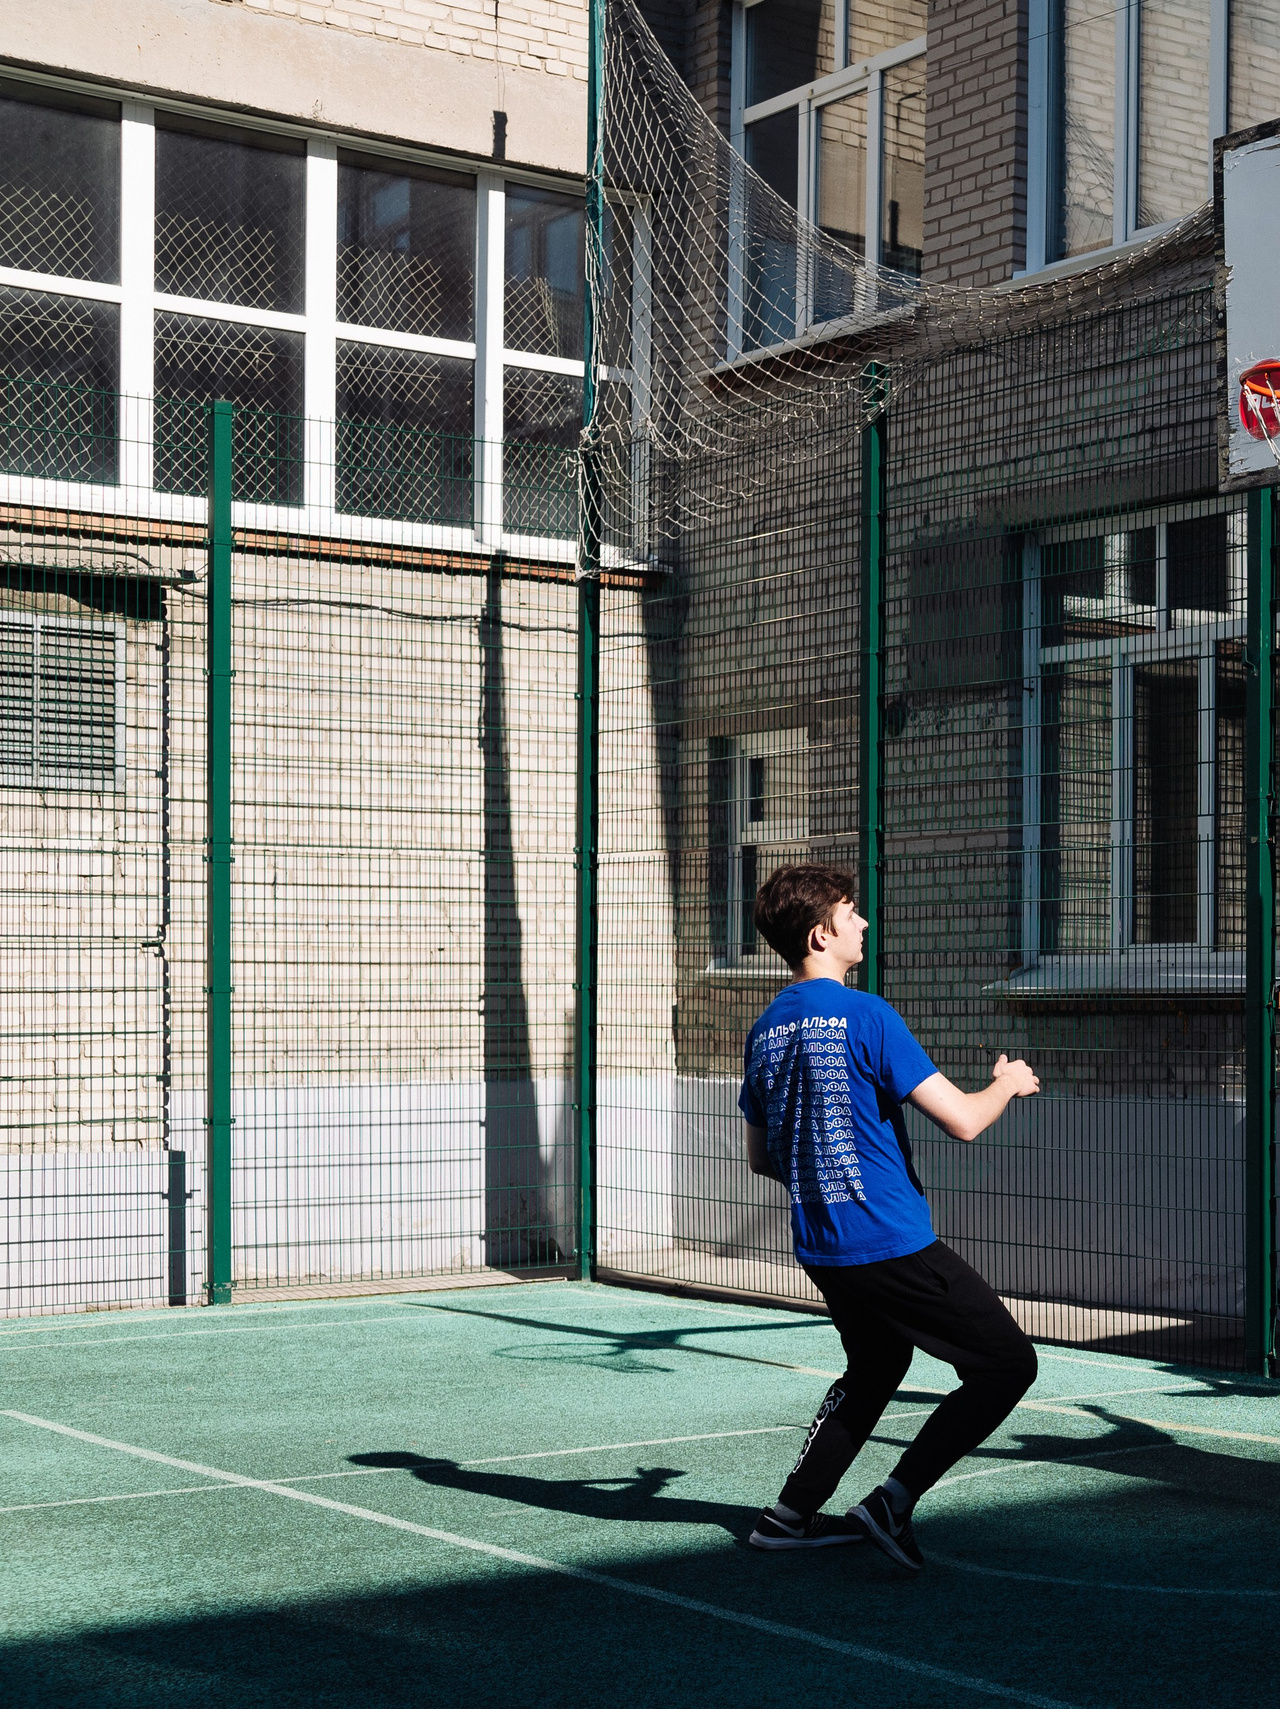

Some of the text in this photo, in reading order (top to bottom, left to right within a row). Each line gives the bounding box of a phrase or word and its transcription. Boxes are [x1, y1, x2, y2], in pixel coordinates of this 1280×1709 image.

[801, 1016, 848, 1029] АЛЬФА
[801, 1029, 847, 1040] АЛЬФА
[802, 1042, 846, 1054] АЛЬФА
[813, 1141, 857, 1156] АЛЬФА
[815, 1153, 860, 1168] АЛЬФА
[816, 1166, 862, 1181] АЛЬФА
[819, 1179, 865, 1193] АЛЬФА
